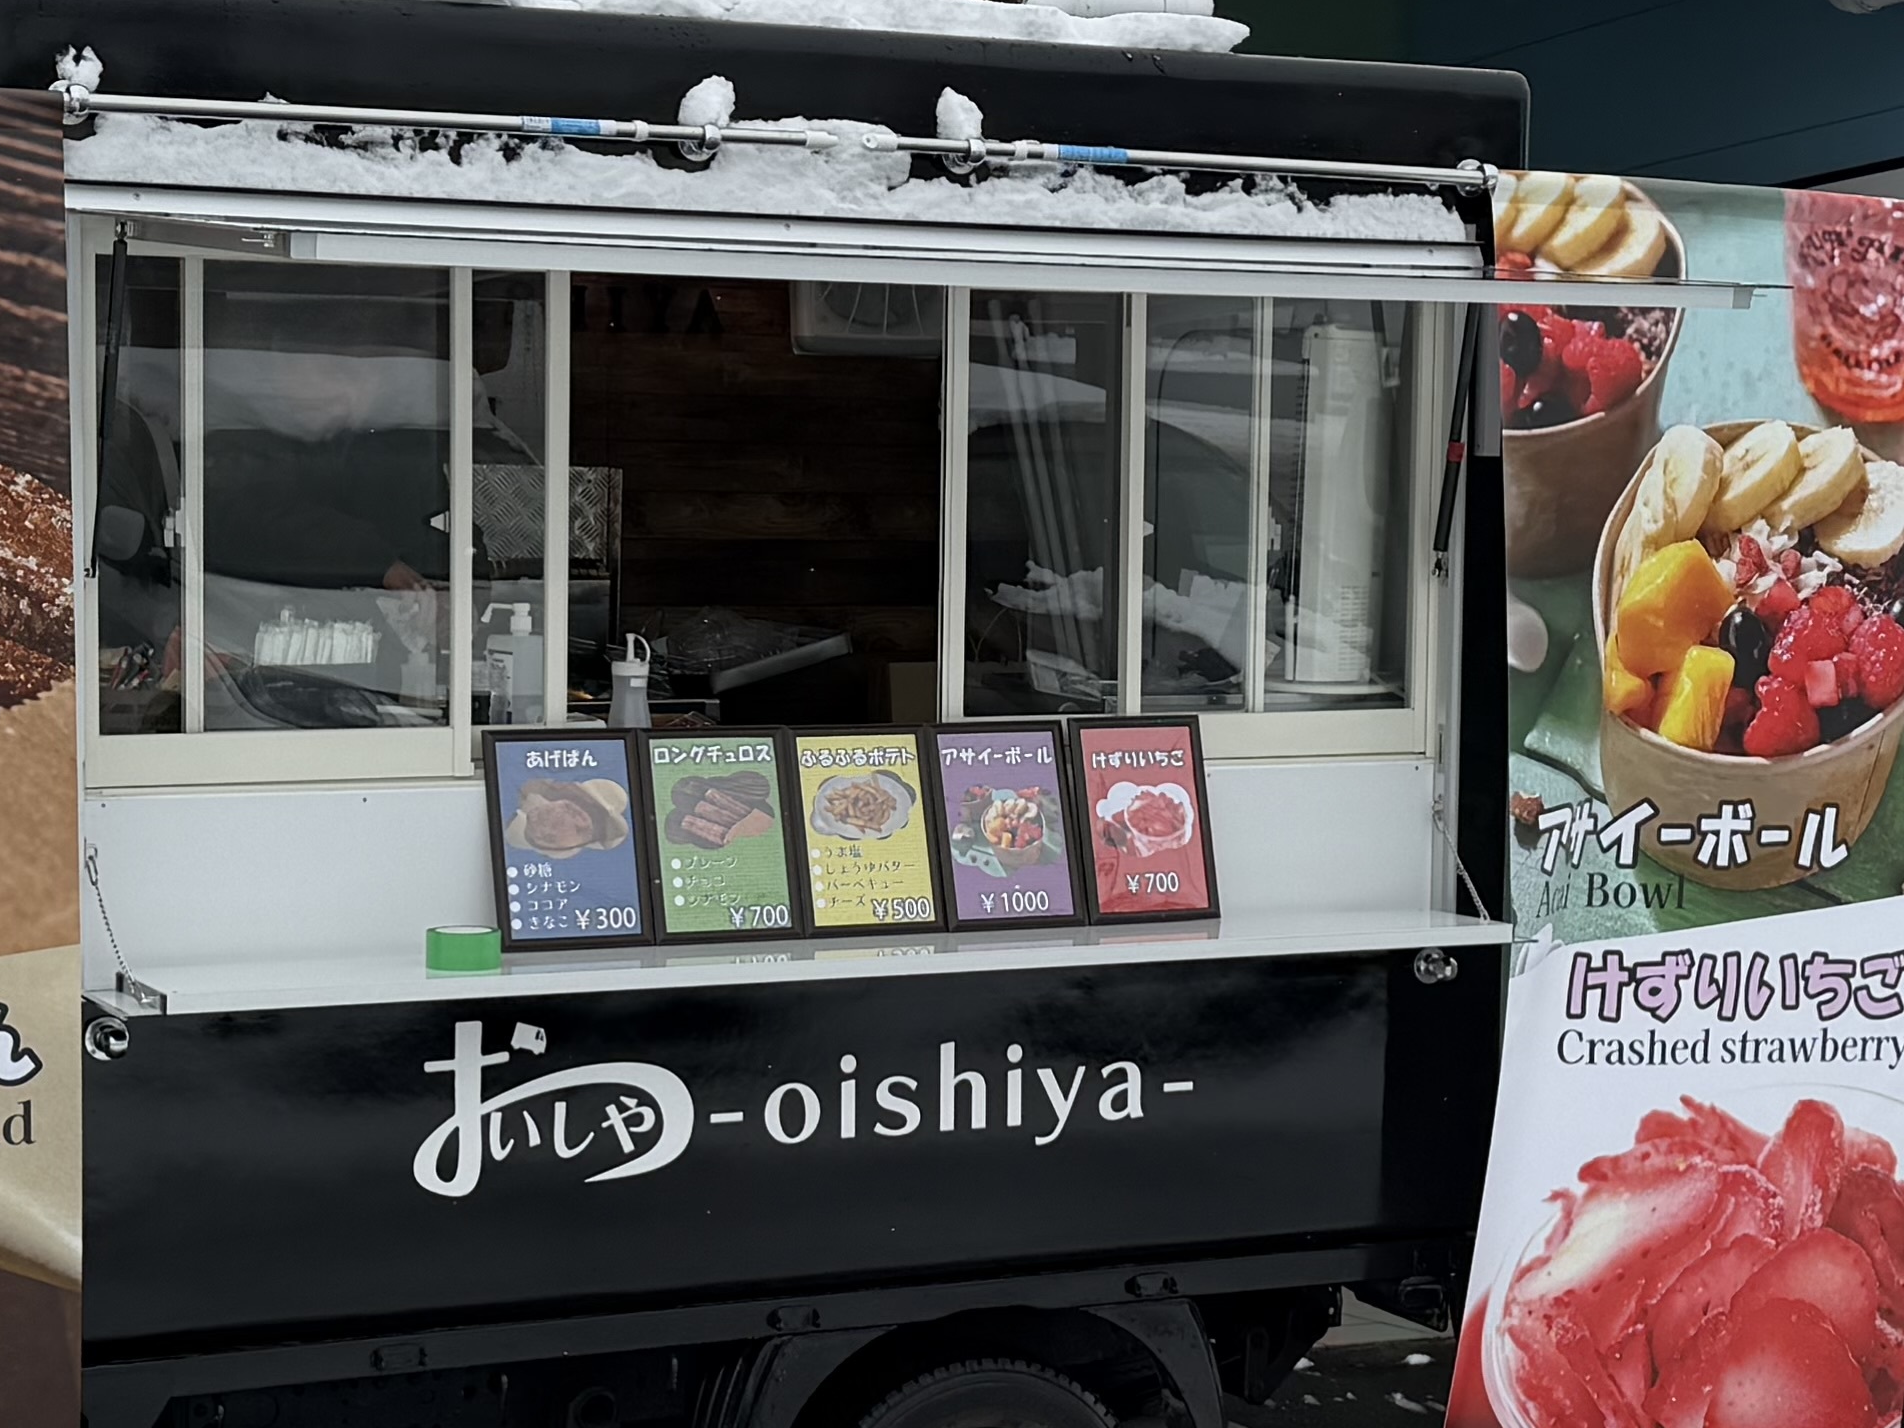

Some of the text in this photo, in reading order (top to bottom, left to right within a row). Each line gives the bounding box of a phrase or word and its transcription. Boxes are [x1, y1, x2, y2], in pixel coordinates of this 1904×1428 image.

[653, 744, 773, 766] ロングチュロス
[941, 746, 1053, 767] アサイーボール
[1092, 750, 1185, 769] けずりいちご
[1585, 871, 1687, 910] Bowl
[528, 898, 569, 912] ココア
[1556, 1027, 1711, 1066] Crashed
